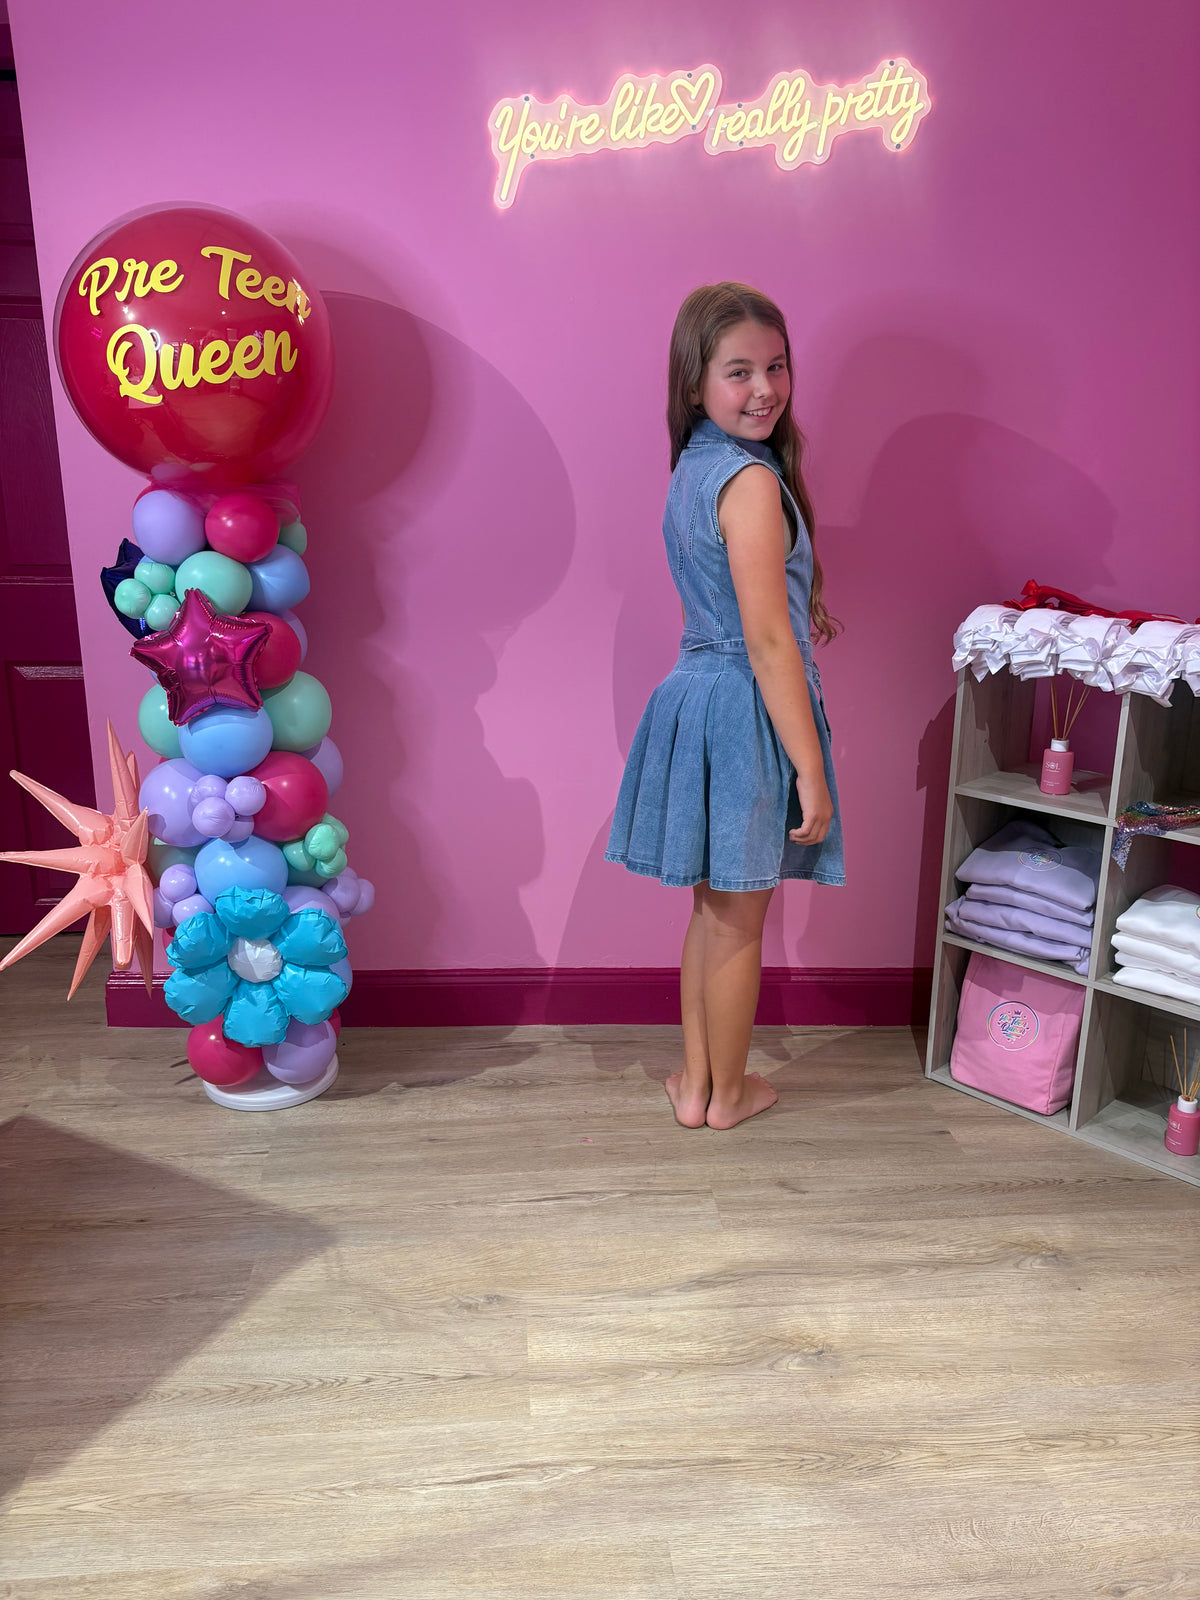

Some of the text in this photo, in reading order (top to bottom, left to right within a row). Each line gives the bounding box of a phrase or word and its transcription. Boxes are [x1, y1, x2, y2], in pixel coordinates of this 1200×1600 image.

[495, 66, 924, 201] You're like really pretty
[78, 246, 311, 319] Pre Teen
[106, 323, 298, 405] Queen
